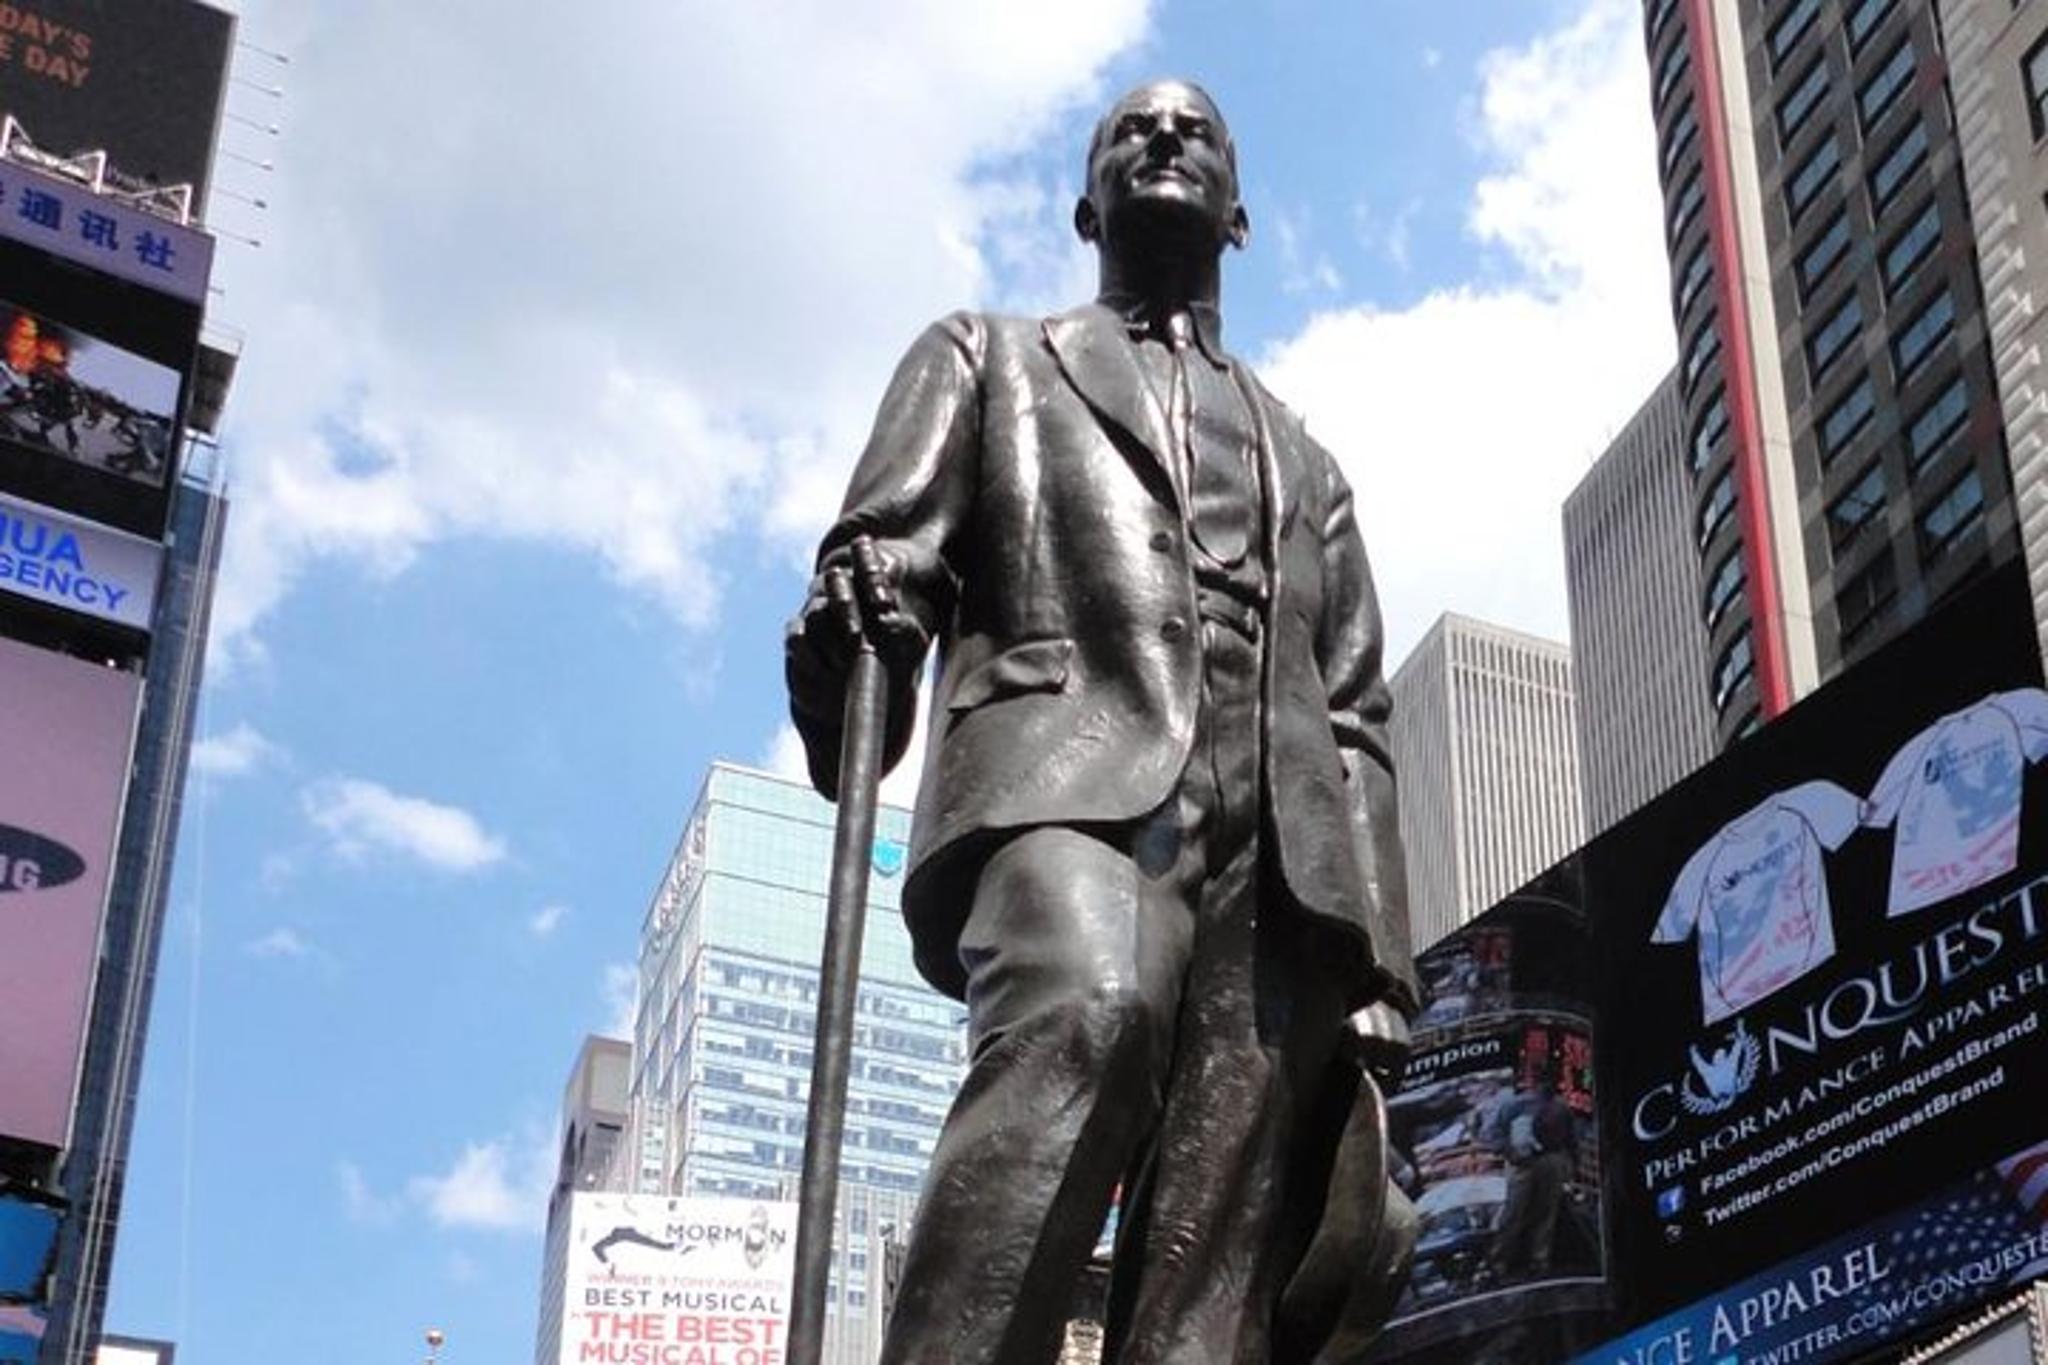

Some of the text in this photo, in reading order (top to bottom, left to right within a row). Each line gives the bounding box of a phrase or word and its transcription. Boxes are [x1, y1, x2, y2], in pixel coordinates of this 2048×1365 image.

[25, 44, 90, 88] DAY
[0, 181, 176, 272] 通讯社
[1900, 963, 2048, 1060] APPAREL
[1701, 1012, 2039, 1196] Facebook.com/ConquestBrand
[1703, 1066, 2005, 1225] Twitter.com/ConquestBrand
[585, 1288, 783, 1314] BEST MUSICAL
[675, 1314, 784, 1346] BEST
[1709, 1241, 1892, 1354] APPAREL
[579, 1341, 727, 1365] MUSICAL
